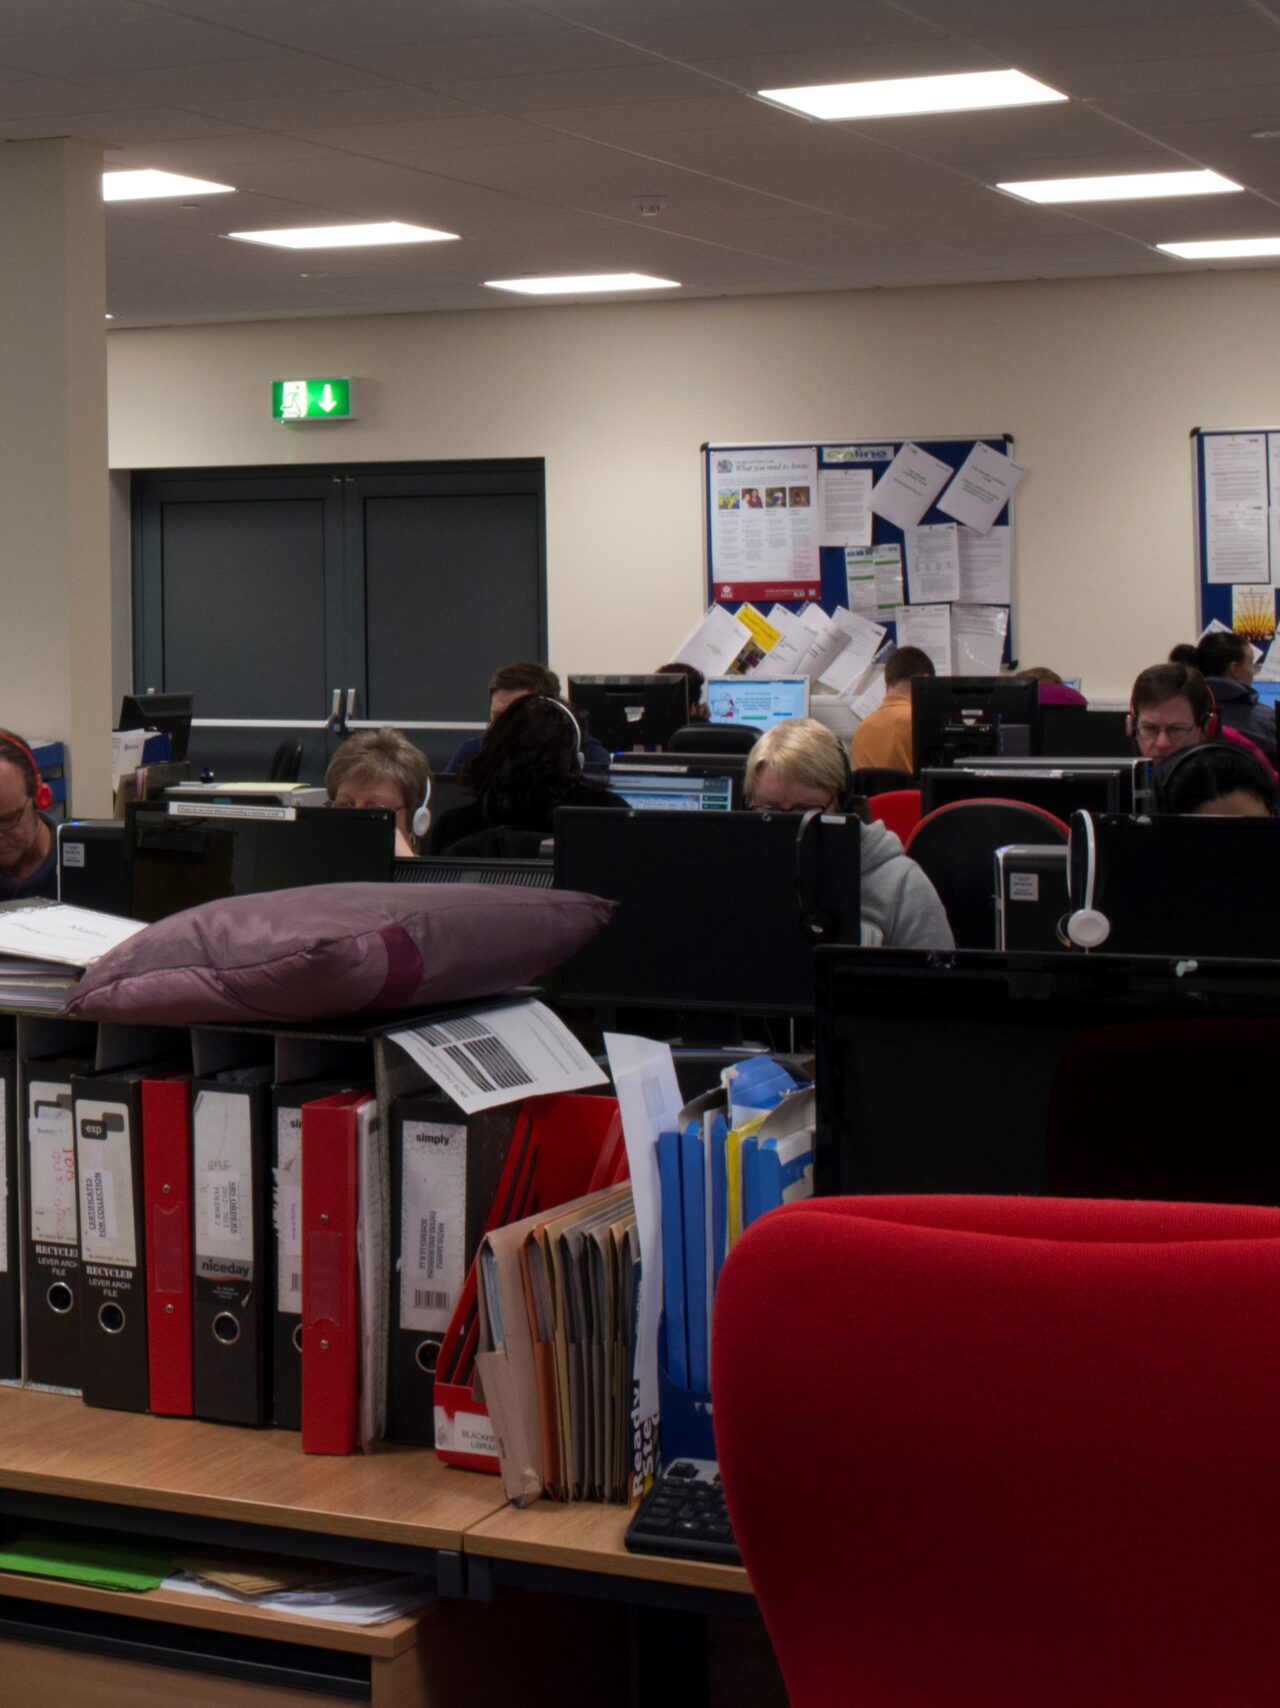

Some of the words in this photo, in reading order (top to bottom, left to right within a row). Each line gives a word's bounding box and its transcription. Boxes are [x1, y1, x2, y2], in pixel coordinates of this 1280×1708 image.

[86, 1124, 102, 1135] exp
[416, 1132, 450, 1146] simply
[95, 1172, 105, 1219] COLLECTION
[85, 1178, 95, 1230] CERTIFICATES
[38, 1257, 60, 1266] LEVER
[52, 1267, 66, 1276] FILE
[86, 1265, 132, 1278] RECYCLED
[202, 1260, 249, 1276] niceday
[89, 1278, 110, 1287] LEVER
[112, 1280, 131, 1289] ARCH
[103, 1289, 117, 1298] FILE
